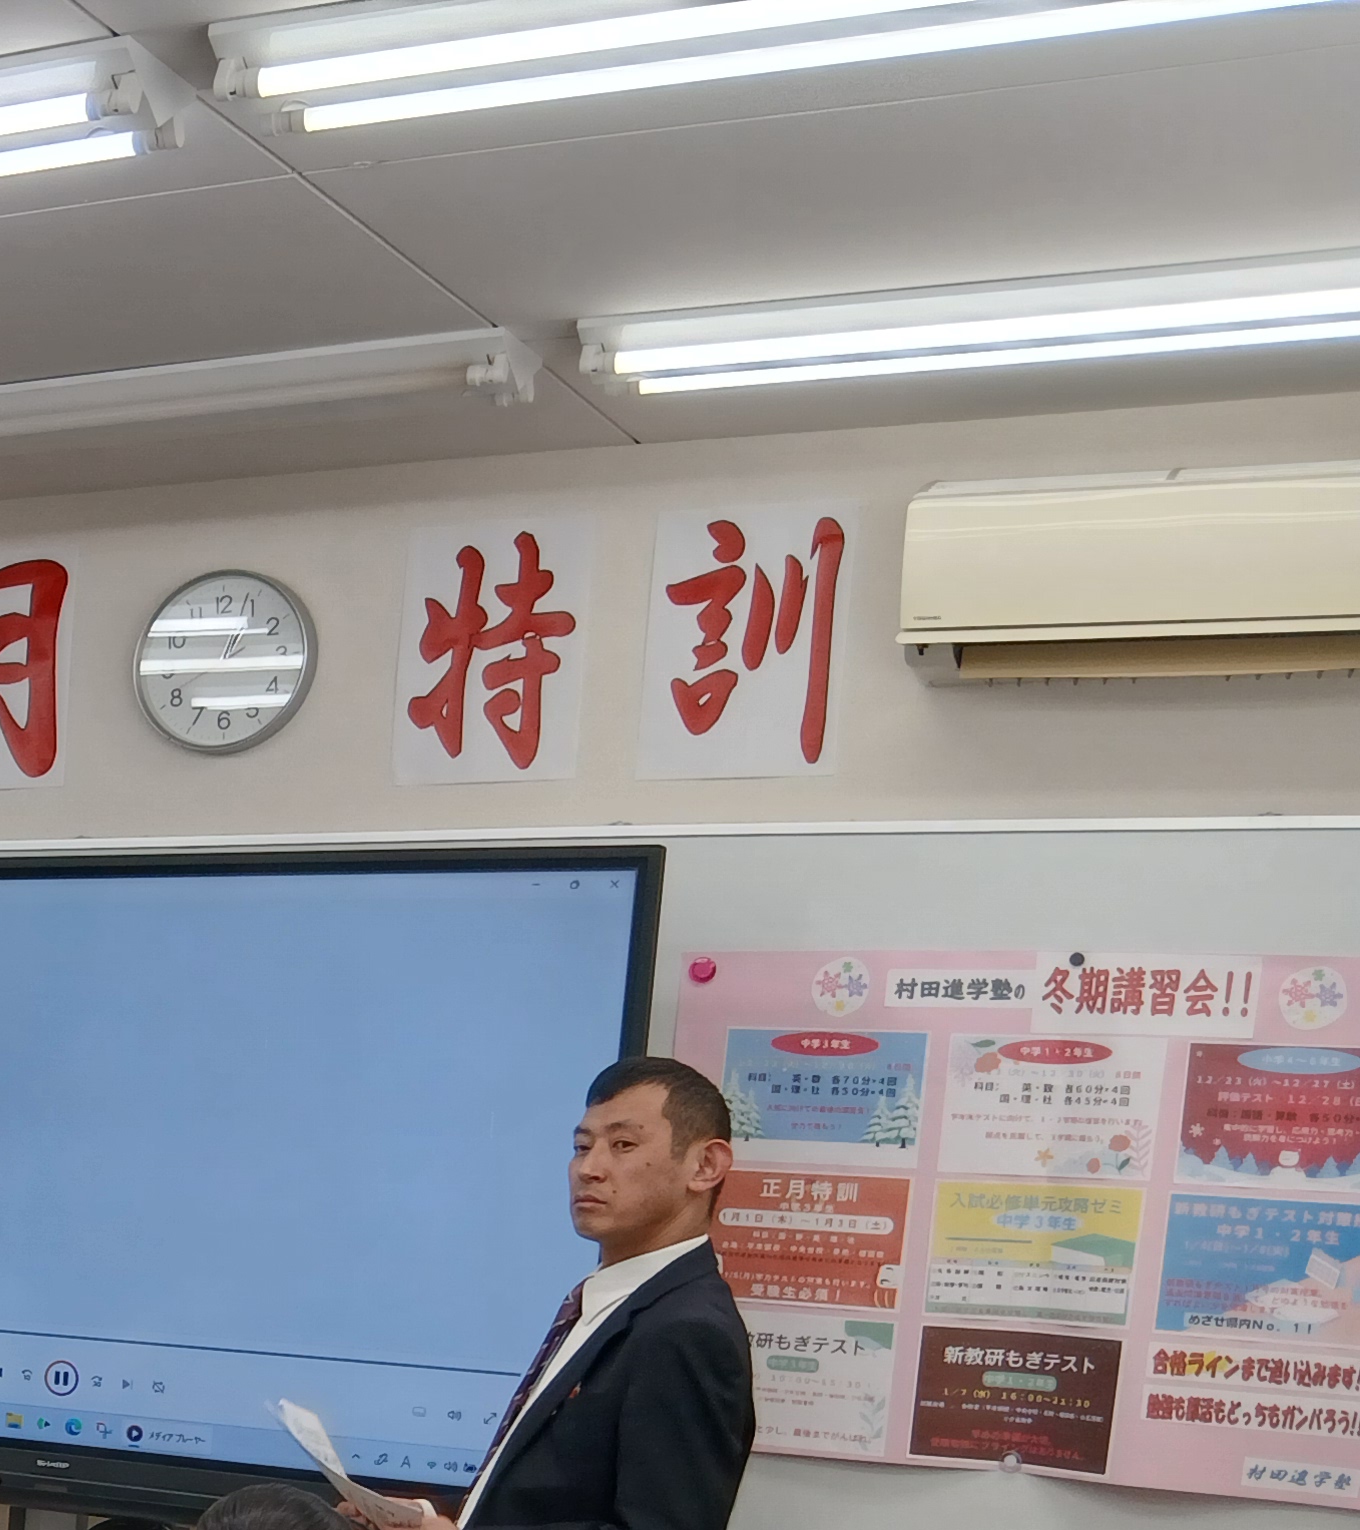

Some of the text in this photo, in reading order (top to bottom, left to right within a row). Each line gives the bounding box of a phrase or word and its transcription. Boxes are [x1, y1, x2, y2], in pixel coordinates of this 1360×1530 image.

[216, 595, 233, 614] 12
[250, 599, 255, 617] 1
[266, 617, 280, 636] 2
[408, 516, 844, 768] 特訓
[265, 676, 279, 693] 4
[170, 689, 183, 707] 8
[191, 707, 207, 726] 7
[217, 710, 230, 729] 6
[894, 966, 1253, 1018] 村田進学塾の 冬期講習会!!
[759, 1178, 859, 1202] 正月特訓
[950, 1192, 1122, 1215] 入試必修単元攻略ゼミ
[997, 1214, 1077, 1231] 中学3年生
[1217, 1224, 1340, 1245] 中学1・2年生
[943, 1345, 1095, 1374] 新教研もぎテスト
